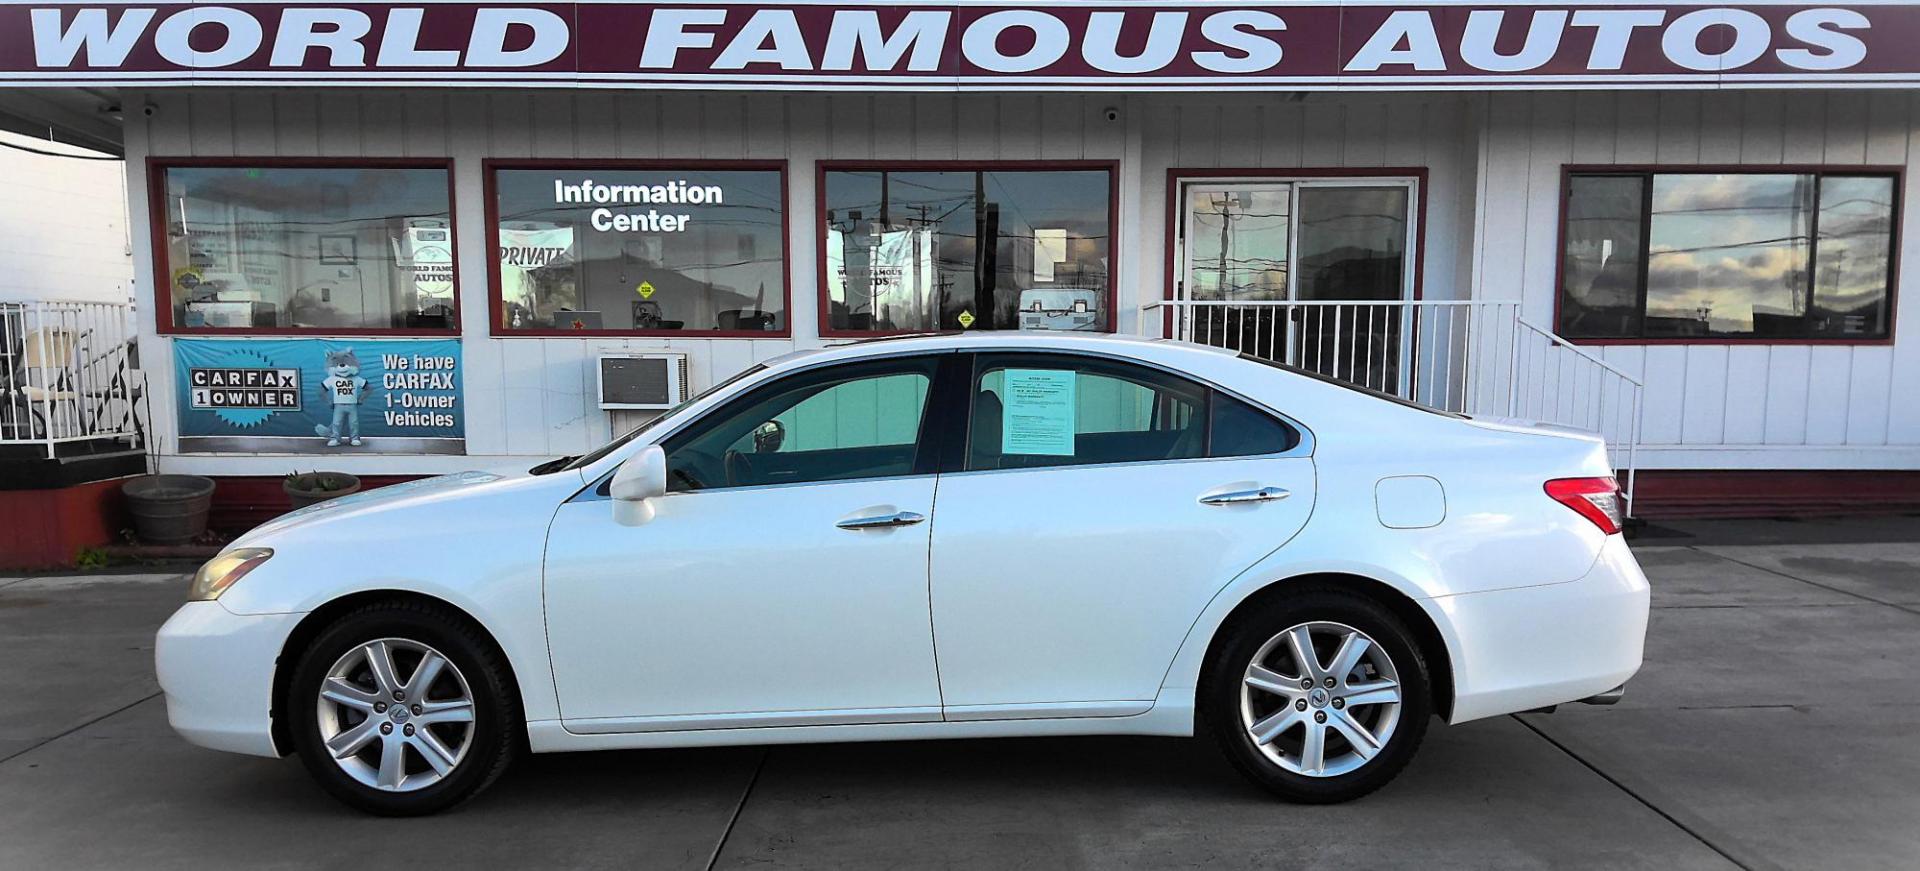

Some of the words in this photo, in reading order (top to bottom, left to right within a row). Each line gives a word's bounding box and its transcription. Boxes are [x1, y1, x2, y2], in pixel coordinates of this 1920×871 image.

[31, 7, 570, 67] WORLD
[640, 9, 1287, 70] FAMOUS
[1343, 8, 1871, 71] AUTOS
[554, 179, 723, 204] Information
[591, 208, 690, 232] Center
[413, 273, 453, 282] AUTOS
[382, 353, 409, 370] We
[413, 353, 455, 370] have
[194, 371, 294, 388] CARFAX
[335, 380, 354, 388] CAR
[382, 372, 455, 390] CARFAX
[337, 388, 355, 396] FOX
[384, 391, 456, 408] 1-Owner
[384, 410, 455, 427] Vehicles
